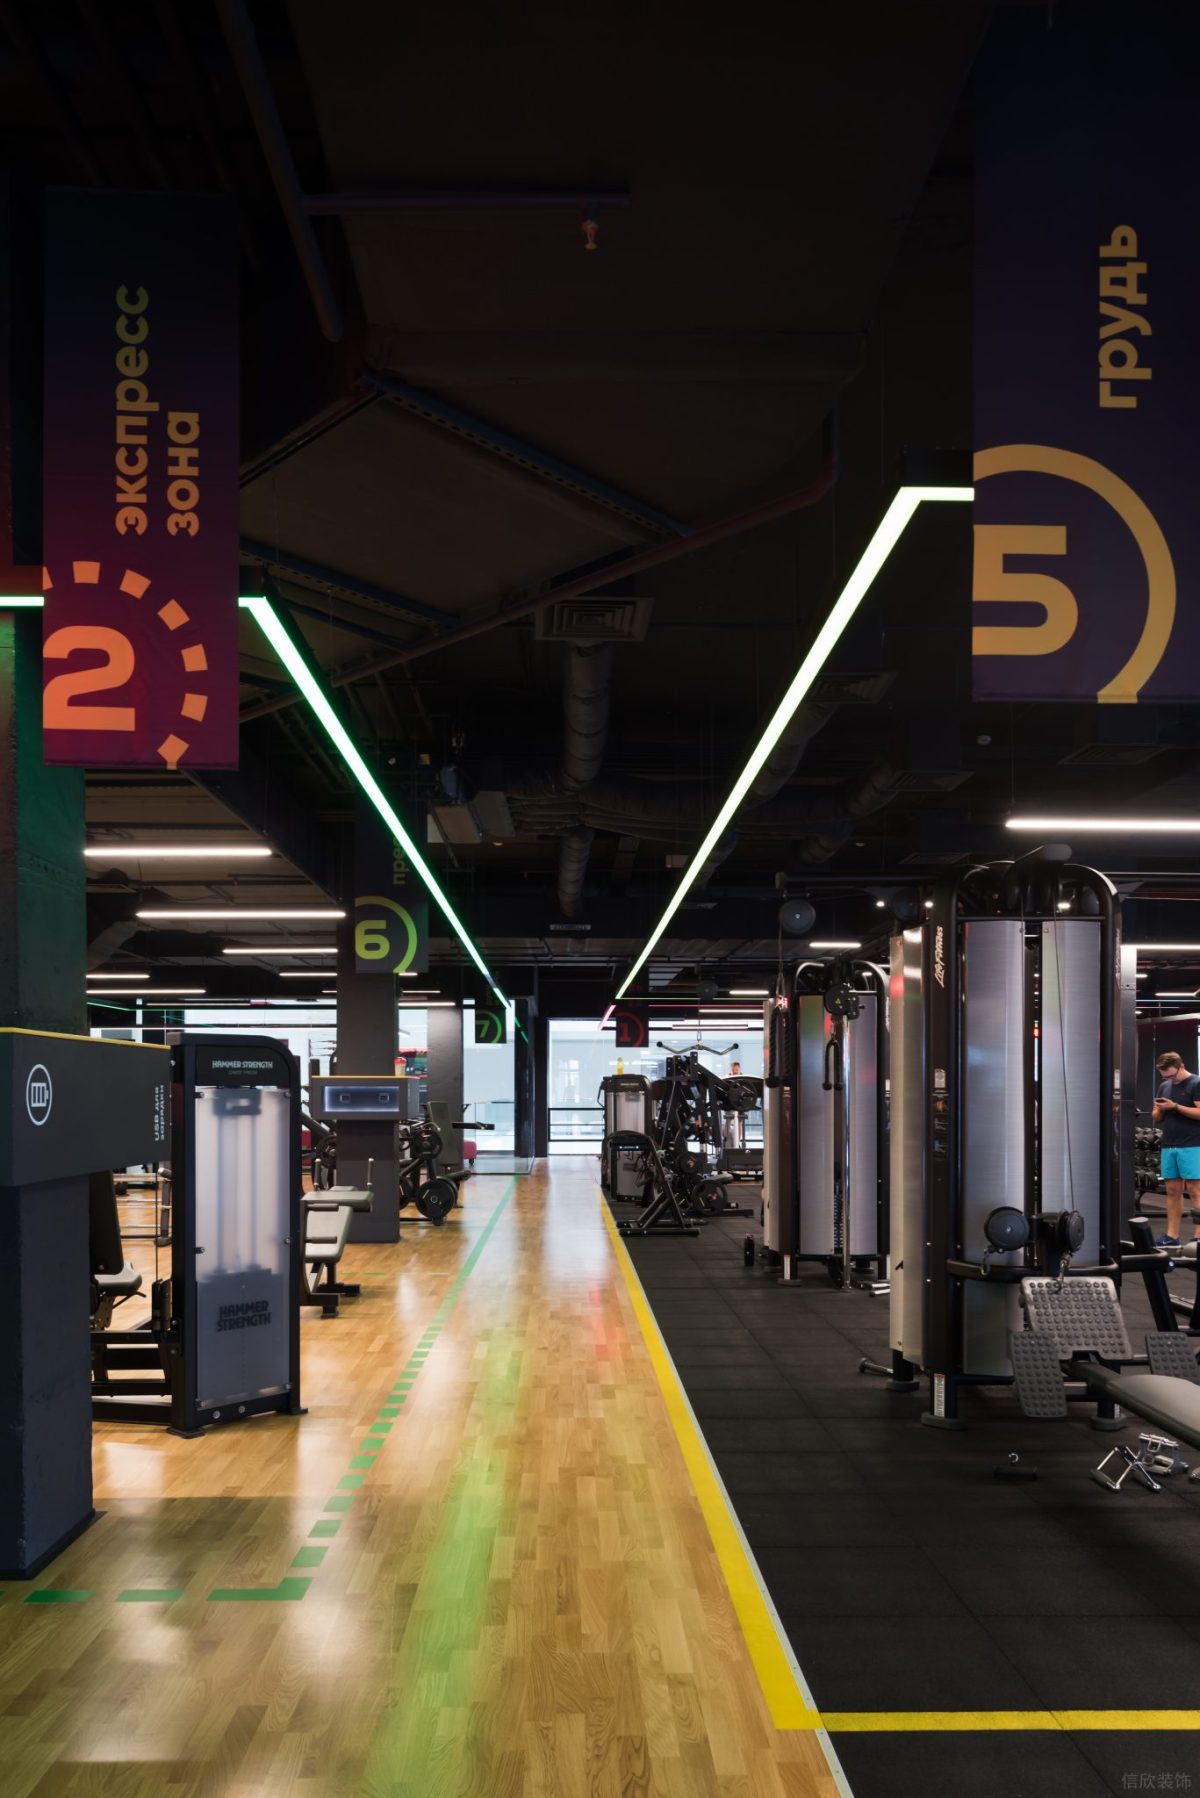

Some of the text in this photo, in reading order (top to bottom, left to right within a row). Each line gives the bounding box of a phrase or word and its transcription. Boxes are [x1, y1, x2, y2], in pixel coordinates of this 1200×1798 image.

[1098, 223, 1153, 409] грудь
[115, 283, 160, 537] экспресс
[166, 410, 201, 537] зона
[972, 524, 1079, 656] 5
[42, 624, 136, 732] 2
[354, 919, 391, 960] 6
[475, 1019, 490, 1039] 7
[618, 1022, 632, 1042] 1
[211, 1059, 273, 1069] HAMMER STRENGTH
[216, 1312, 272, 1333] STRENGTH
[218, 1300, 269, 1320] HAMMER
